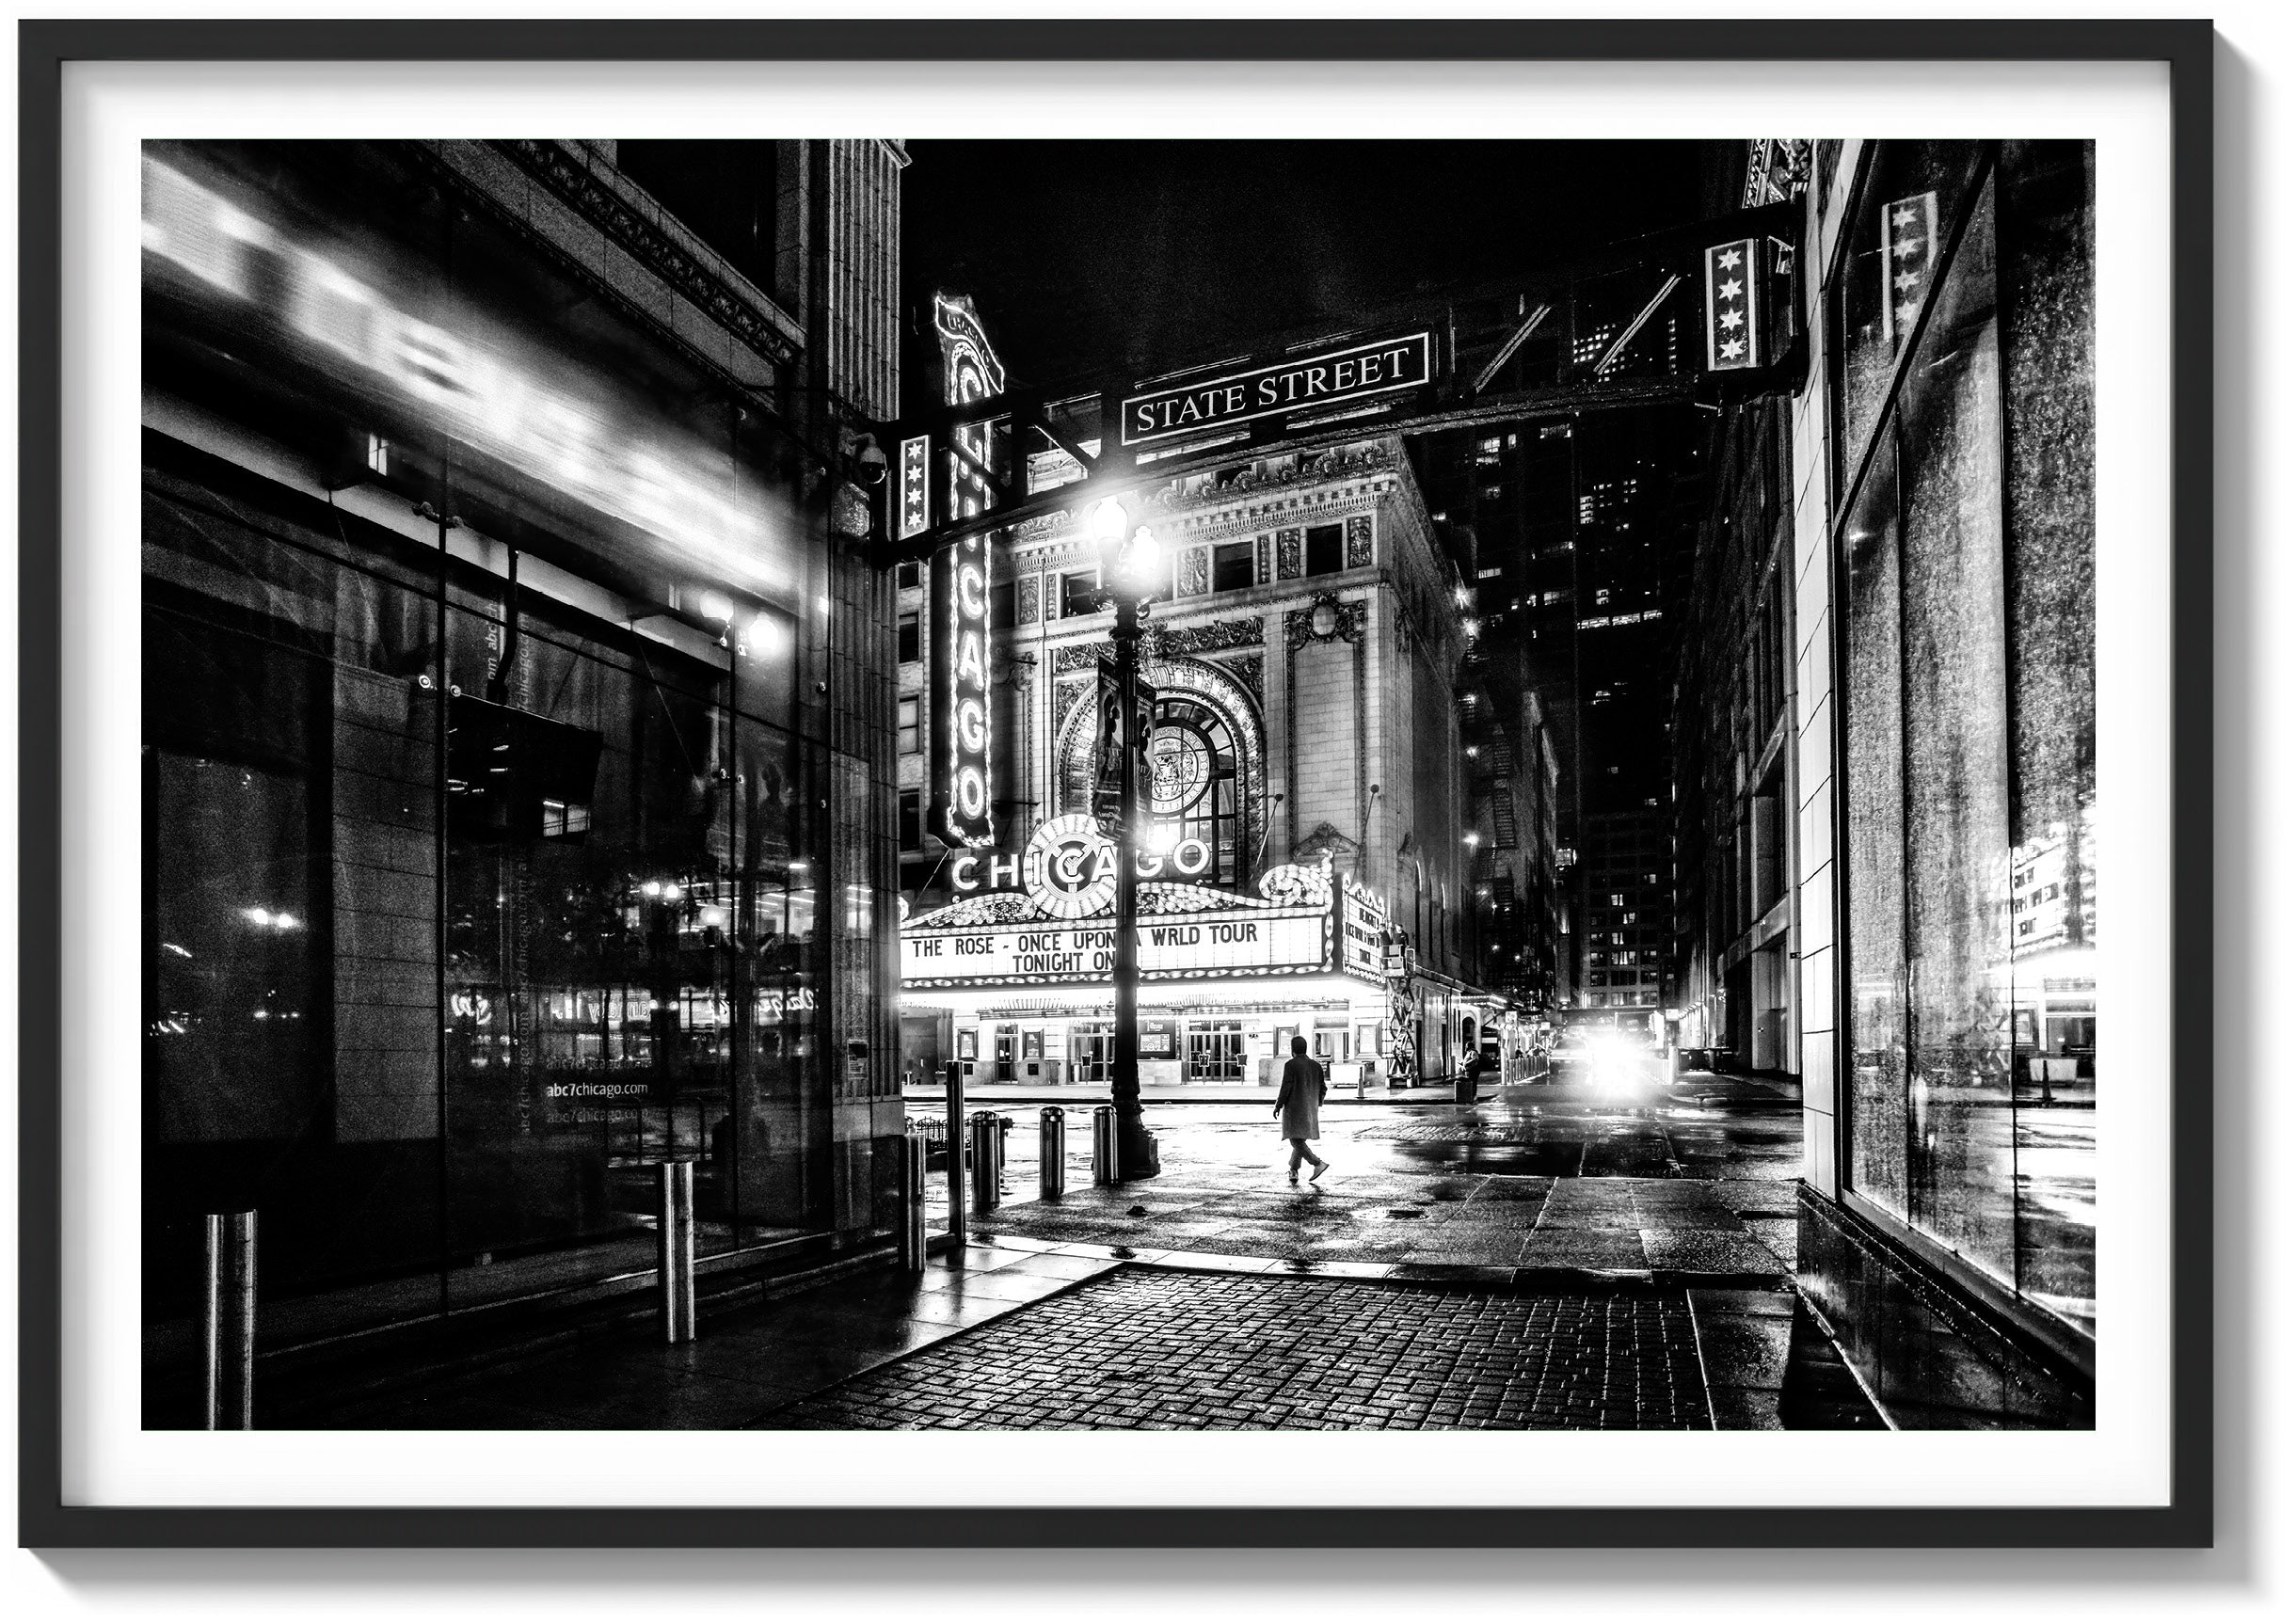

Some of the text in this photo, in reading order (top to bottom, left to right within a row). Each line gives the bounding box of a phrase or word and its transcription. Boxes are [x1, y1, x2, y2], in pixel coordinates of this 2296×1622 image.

[1137, 347, 1410, 433] STATE STREET
[952, 837, 1211, 891] CHICAGO
[913, 939, 943, 958] THE
[955, 936, 995, 956] ROSE
[1018, 932, 1061, 953] ONCE
[1074, 930, 1116, 949] UPON
[1151, 926, 1201, 946] WRLD
[1208, 923, 1258, 944] TOUR
[1012, 952, 1084, 974] TONIGHT
[547, 1082, 648, 1099] abc7chicago.com
